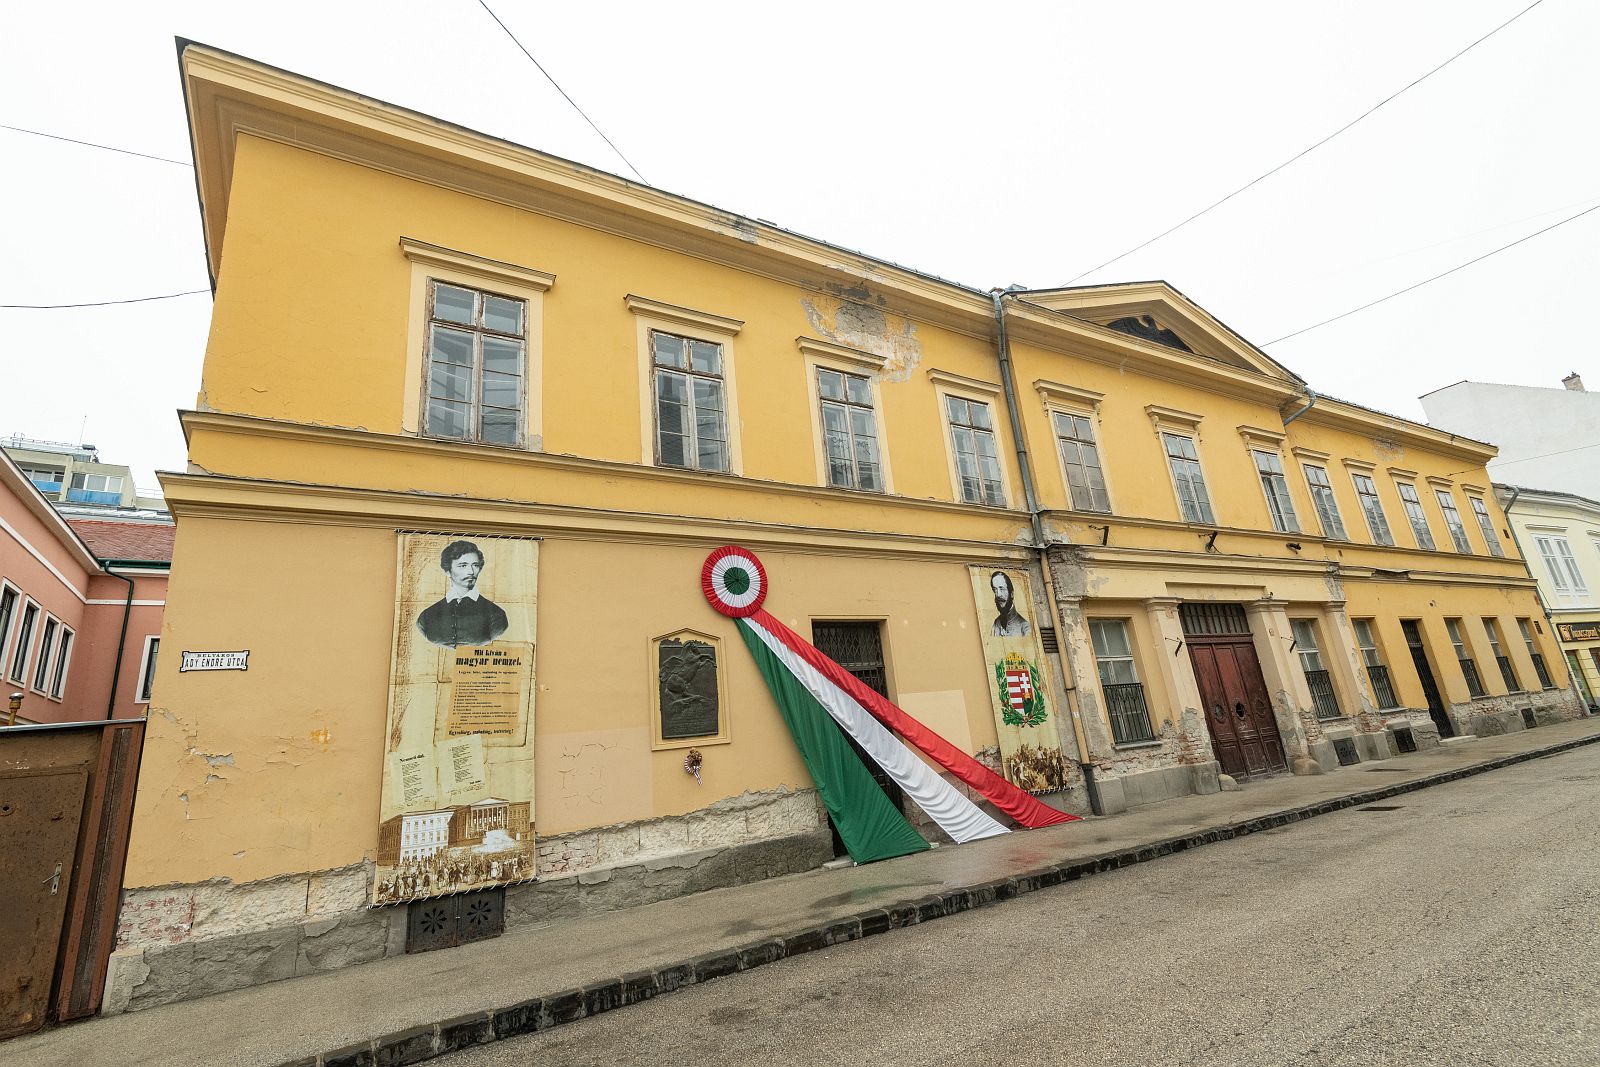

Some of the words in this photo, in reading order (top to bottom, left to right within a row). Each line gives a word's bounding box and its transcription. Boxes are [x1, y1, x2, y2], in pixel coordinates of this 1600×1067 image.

[185, 659, 198, 667] ADY
[202, 658, 224, 666] ENDRE
[227, 658, 244, 666] UTCA
[455, 657, 489, 667] magyar
[492, 657, 521, 666] nemzet.
